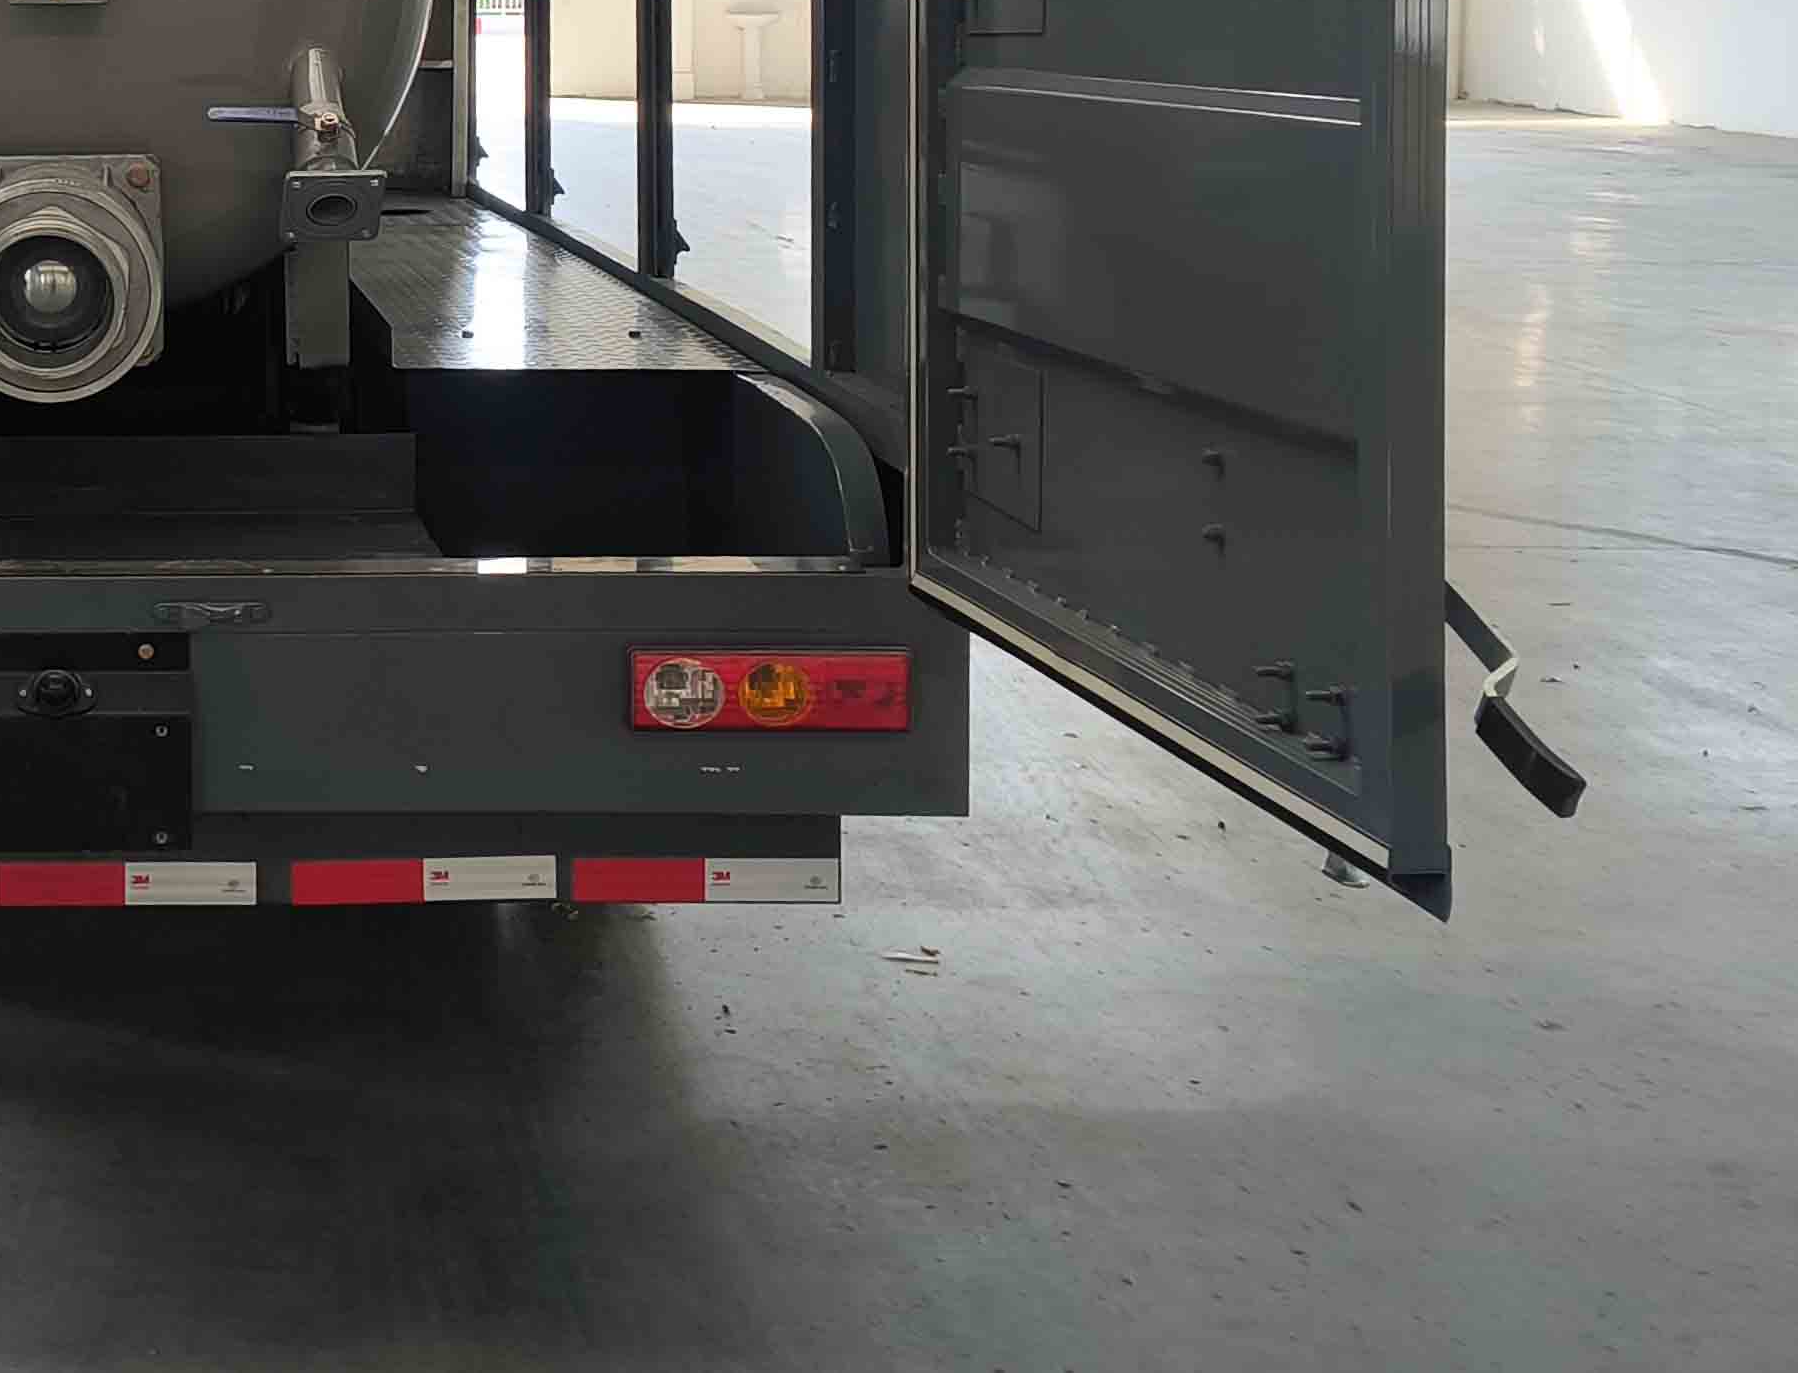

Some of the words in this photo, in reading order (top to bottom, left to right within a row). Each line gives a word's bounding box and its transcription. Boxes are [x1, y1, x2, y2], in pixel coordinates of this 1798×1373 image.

[131, 875, 151, 885] 3M
[430, 871, 450, 881] 3M
[712, 871, 731, 881] 3M
